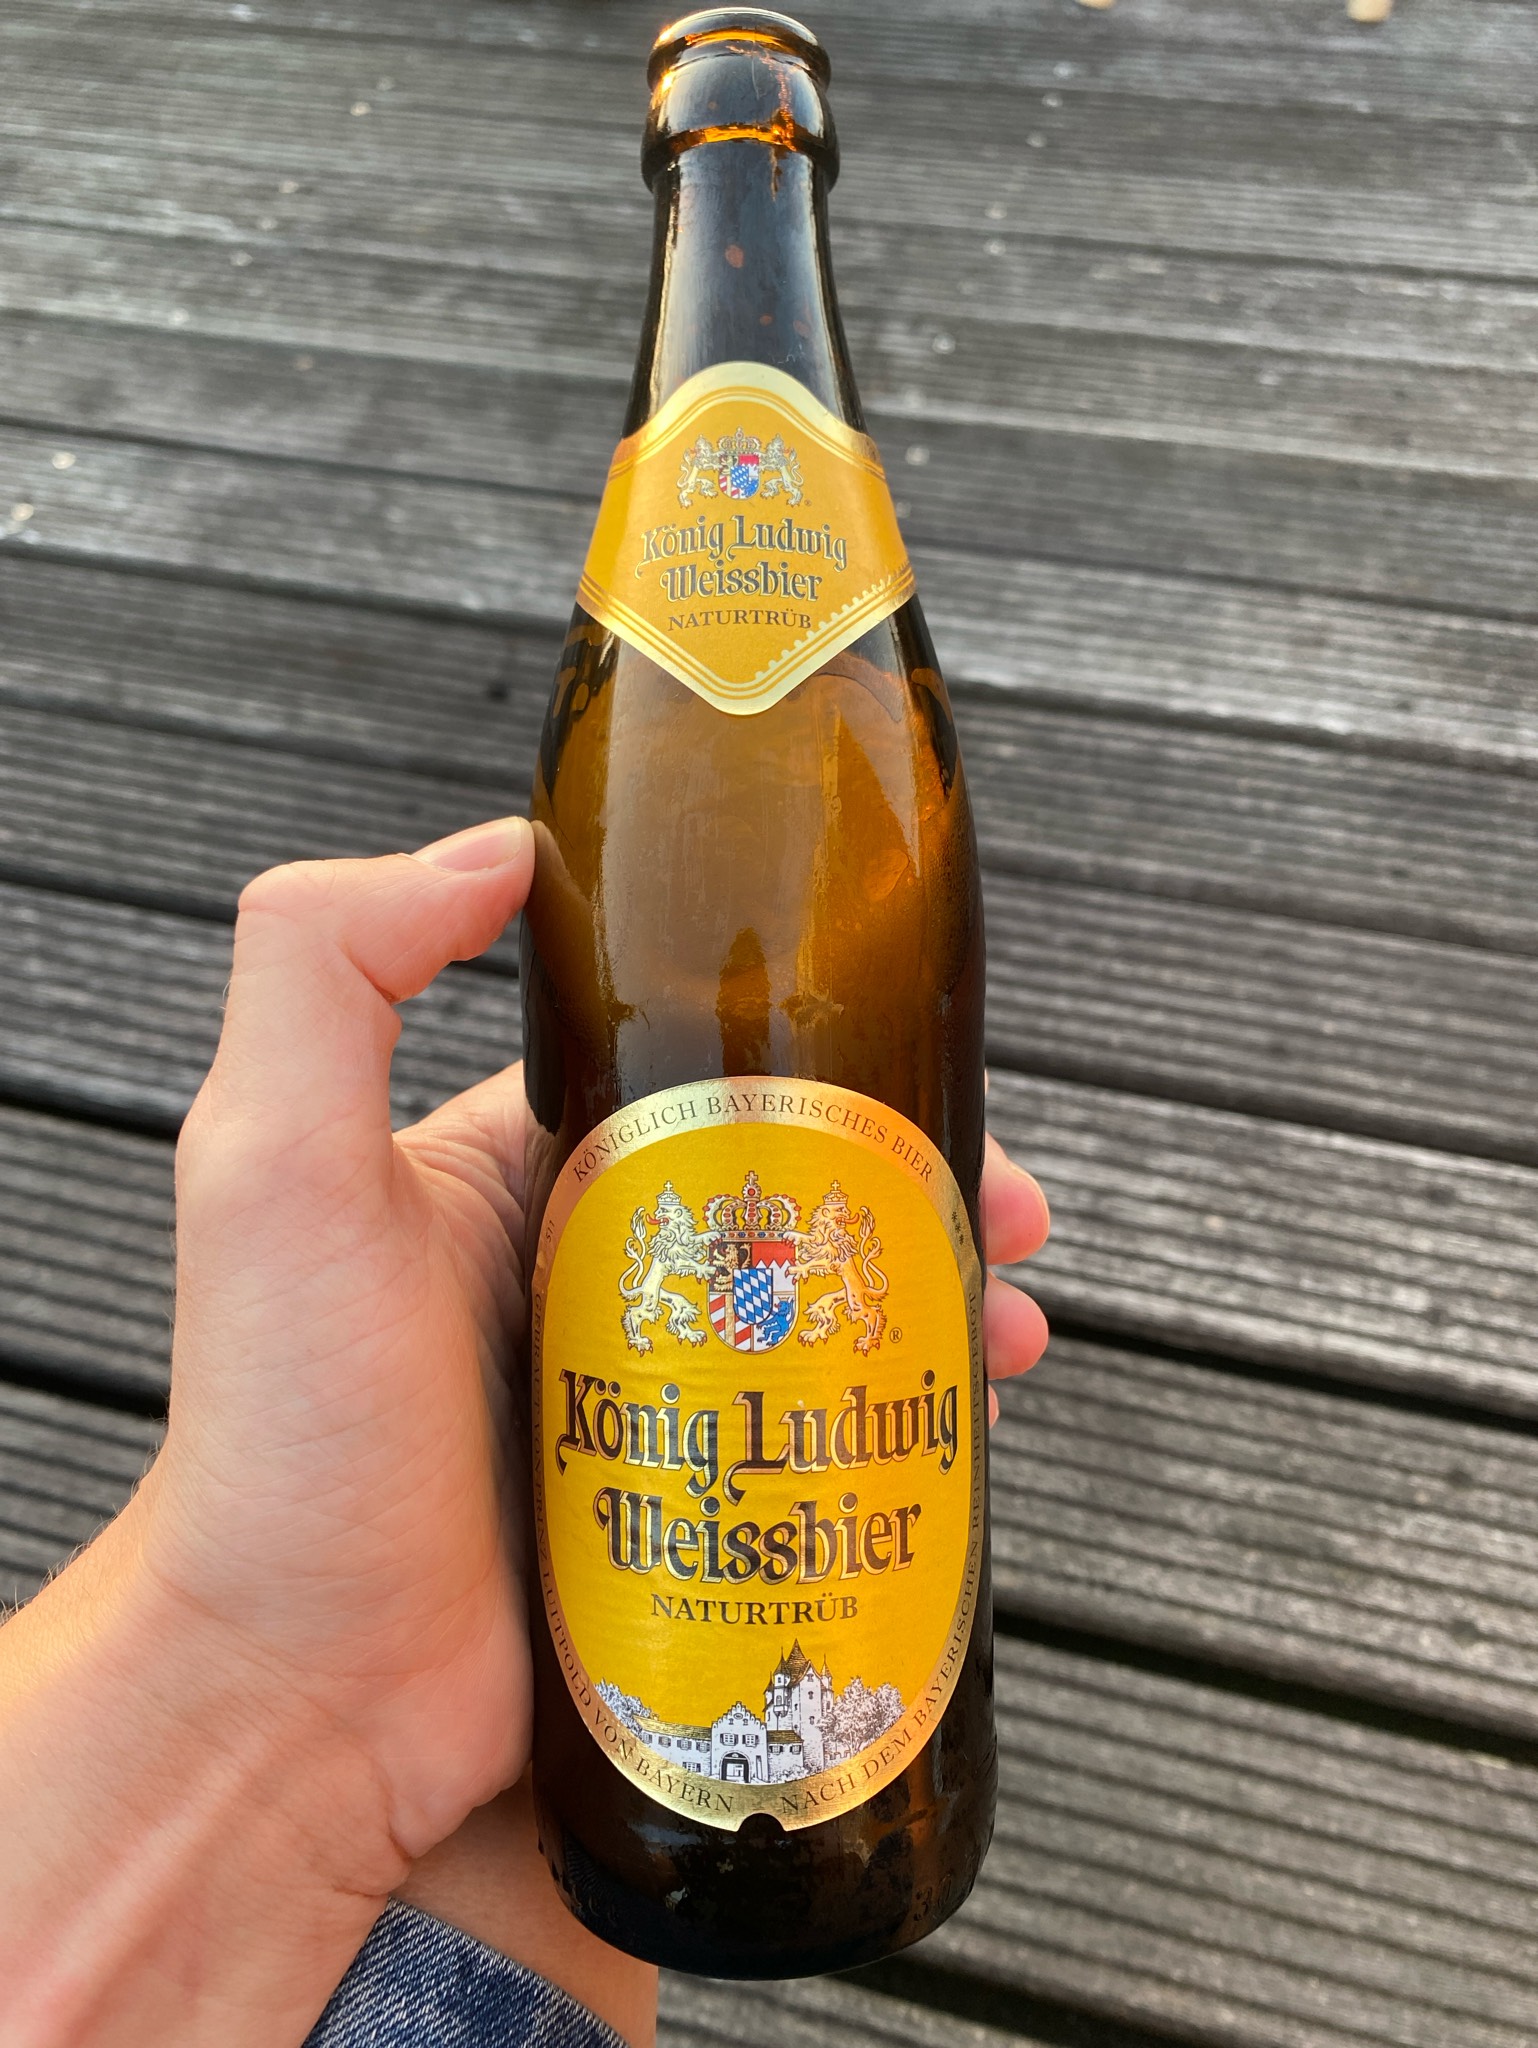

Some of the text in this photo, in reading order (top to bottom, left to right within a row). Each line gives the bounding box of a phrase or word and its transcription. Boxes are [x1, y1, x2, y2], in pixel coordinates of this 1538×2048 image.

[635, 515, 848, 580] König Ludwig
[660, 560, 823, 603] Weissbier
[667, 608, 812, 632] NATURTRÜB
[573, 1093, 933, 1183] KÖNIGLICH BAYERISCHES BIER
[556, 1368, 959, 1507] König Ludwig
[593, 1486, 922, 1586] Weissbier
[780, 1292, 980, 1814] NACH DEM BAYERISCHEN REINHEITSGEBOT
[650, 1592, 859, 1626] NATURTRÜB
[542, 1572, 592, 1708] LUITPOLD
[594, 1708, 636, 1761] VON
[636, 1757, 734, 1814] BAYERN
